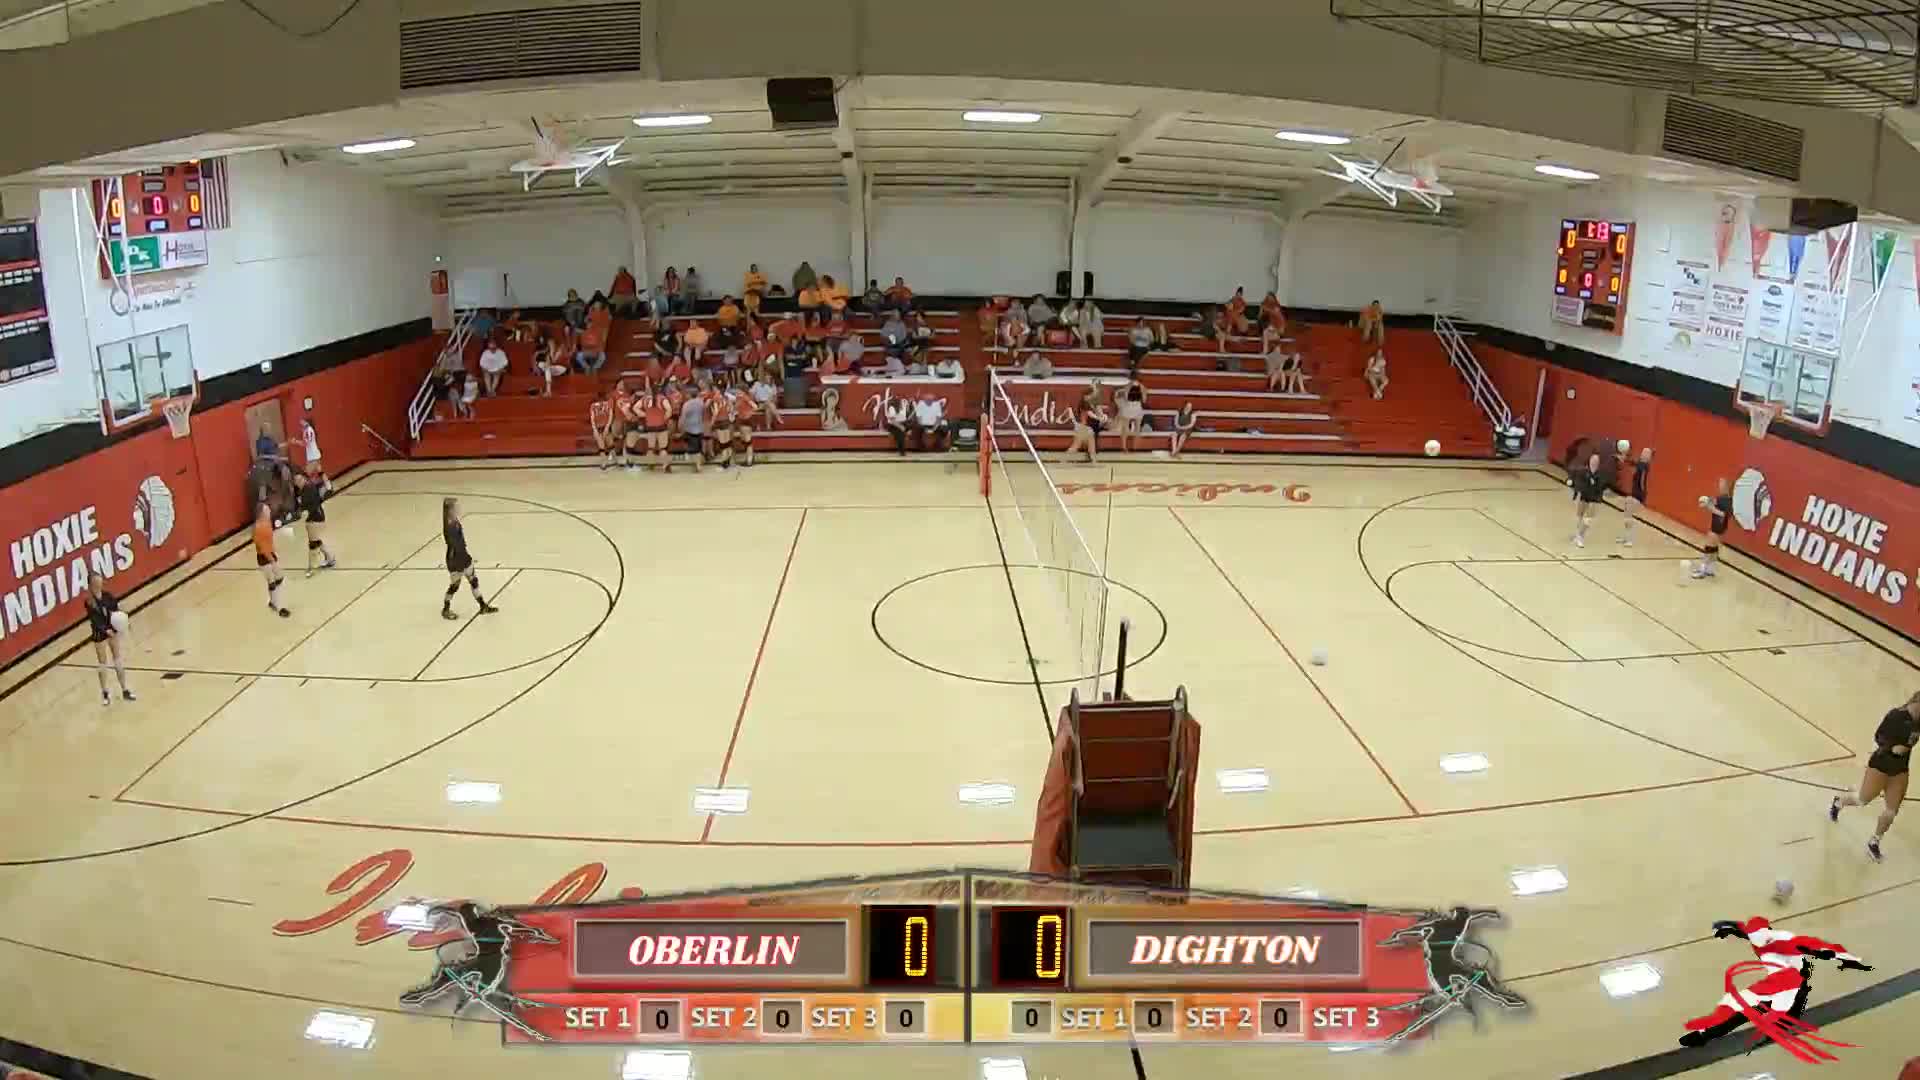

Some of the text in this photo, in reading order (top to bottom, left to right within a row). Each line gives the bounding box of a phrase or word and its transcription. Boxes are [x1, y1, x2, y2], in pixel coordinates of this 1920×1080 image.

[153, 195, 163, 215] 0
[190, 194, 200, 214] 0
[1567, 230, 1577, 248] 0
[1616, 234, 1626, 253] 0
[1559, 269, 1568, 283] 0
[1584, 272, 1593, 287] 0
[1611, 277, 1620, 292] 0
[1802, 494, 1888, 554] HOXIE
[10, 505, 99, 579] HOXIE
[1768, 517, 1908, 604] INDIANS
